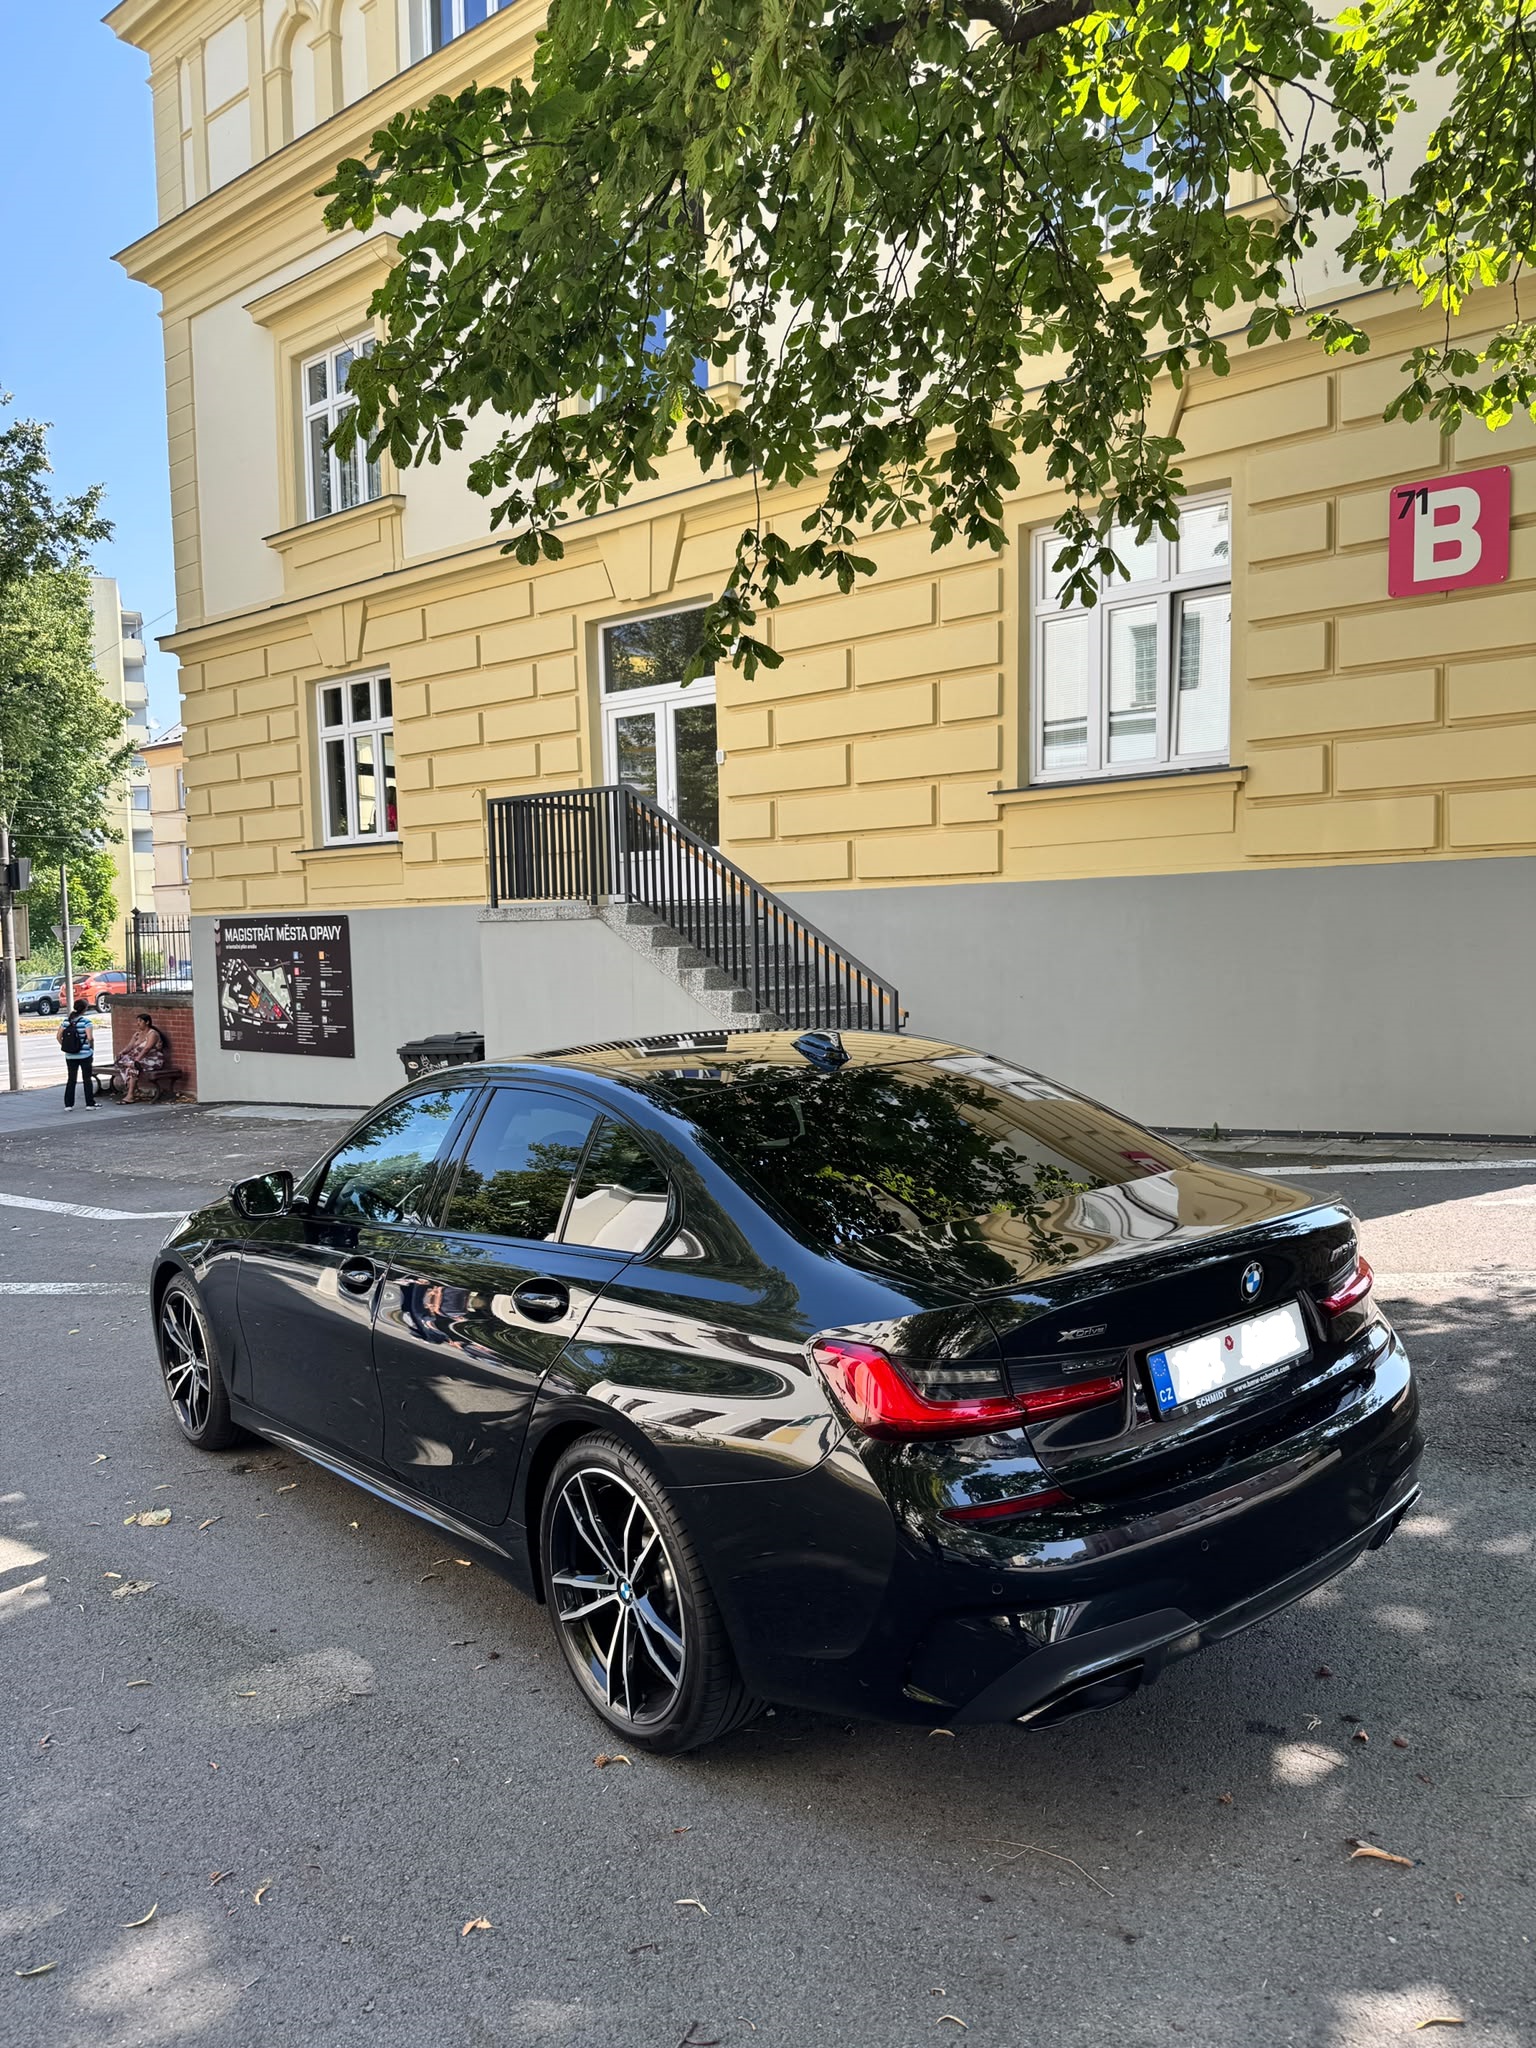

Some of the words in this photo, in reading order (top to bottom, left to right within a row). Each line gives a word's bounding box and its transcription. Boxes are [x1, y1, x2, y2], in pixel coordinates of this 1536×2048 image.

[1397, 487, 1429, 520] 71
[1413, 486, 1482, 583] B
[225, 924, 275, 942] MAGISTRÁT
[276, 923, 309, 941] MĚSTA
[309, 925, 342, 941] OPAVY
[1159, 1387, 1174, 1403] CZ
[1195, 1389, 1228, 1409] SCHMIDT
[1233, 1365, 1291, 1393] www.bmw-schmidt.com
